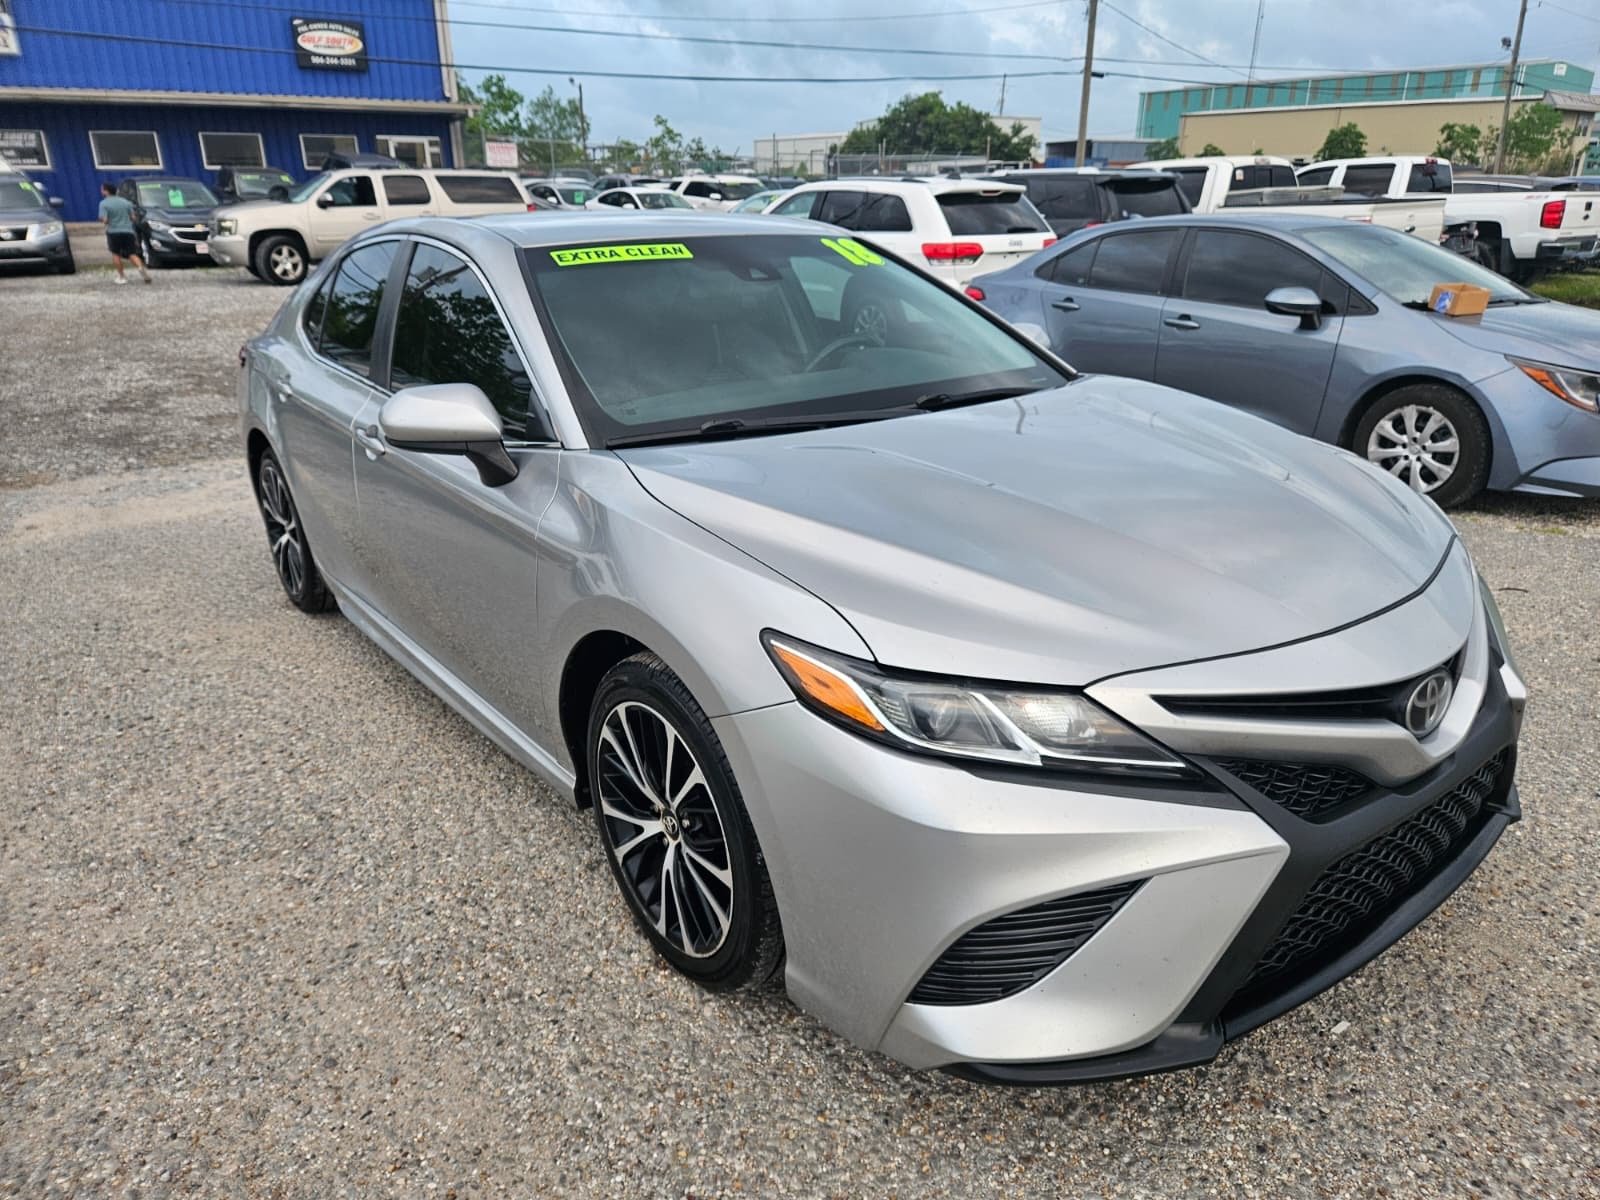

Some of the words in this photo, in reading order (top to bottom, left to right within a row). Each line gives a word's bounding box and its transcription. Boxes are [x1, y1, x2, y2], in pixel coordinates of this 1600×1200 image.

[301, 35, 322, 45] GULF
[326, 35, 353, 46] SOUTH
[556, 249, 621, 262] EXTRA
[625, 246, 684, 257] CLEAN
